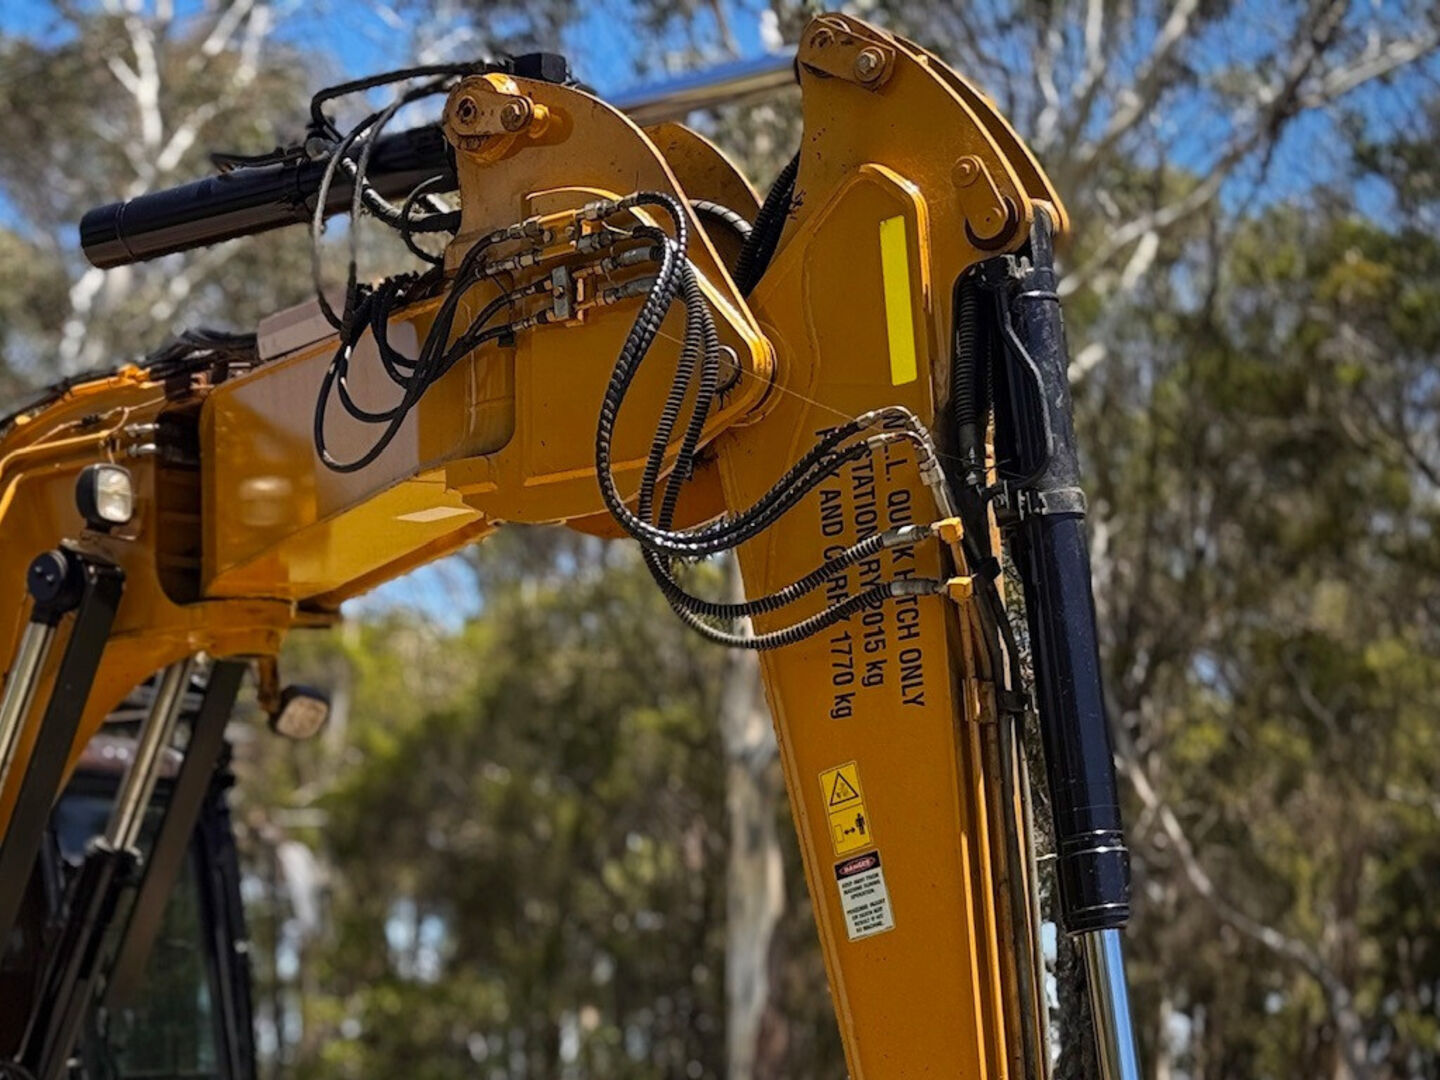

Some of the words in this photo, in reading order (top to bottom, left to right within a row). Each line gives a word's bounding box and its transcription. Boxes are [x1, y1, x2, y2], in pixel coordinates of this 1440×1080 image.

[819, 490, 844, 537] AND
[851, 449, 882, 588] STATIONRY
[888, 489, 915, 563] QUIK
[894, 568, 920, 641] HTCH
[830, 630, 855, 686] 1770
[862, 659, 887, 688] kg
[899, 648, 925, 706] ONLY
[830, 692, 856, 719] kg
